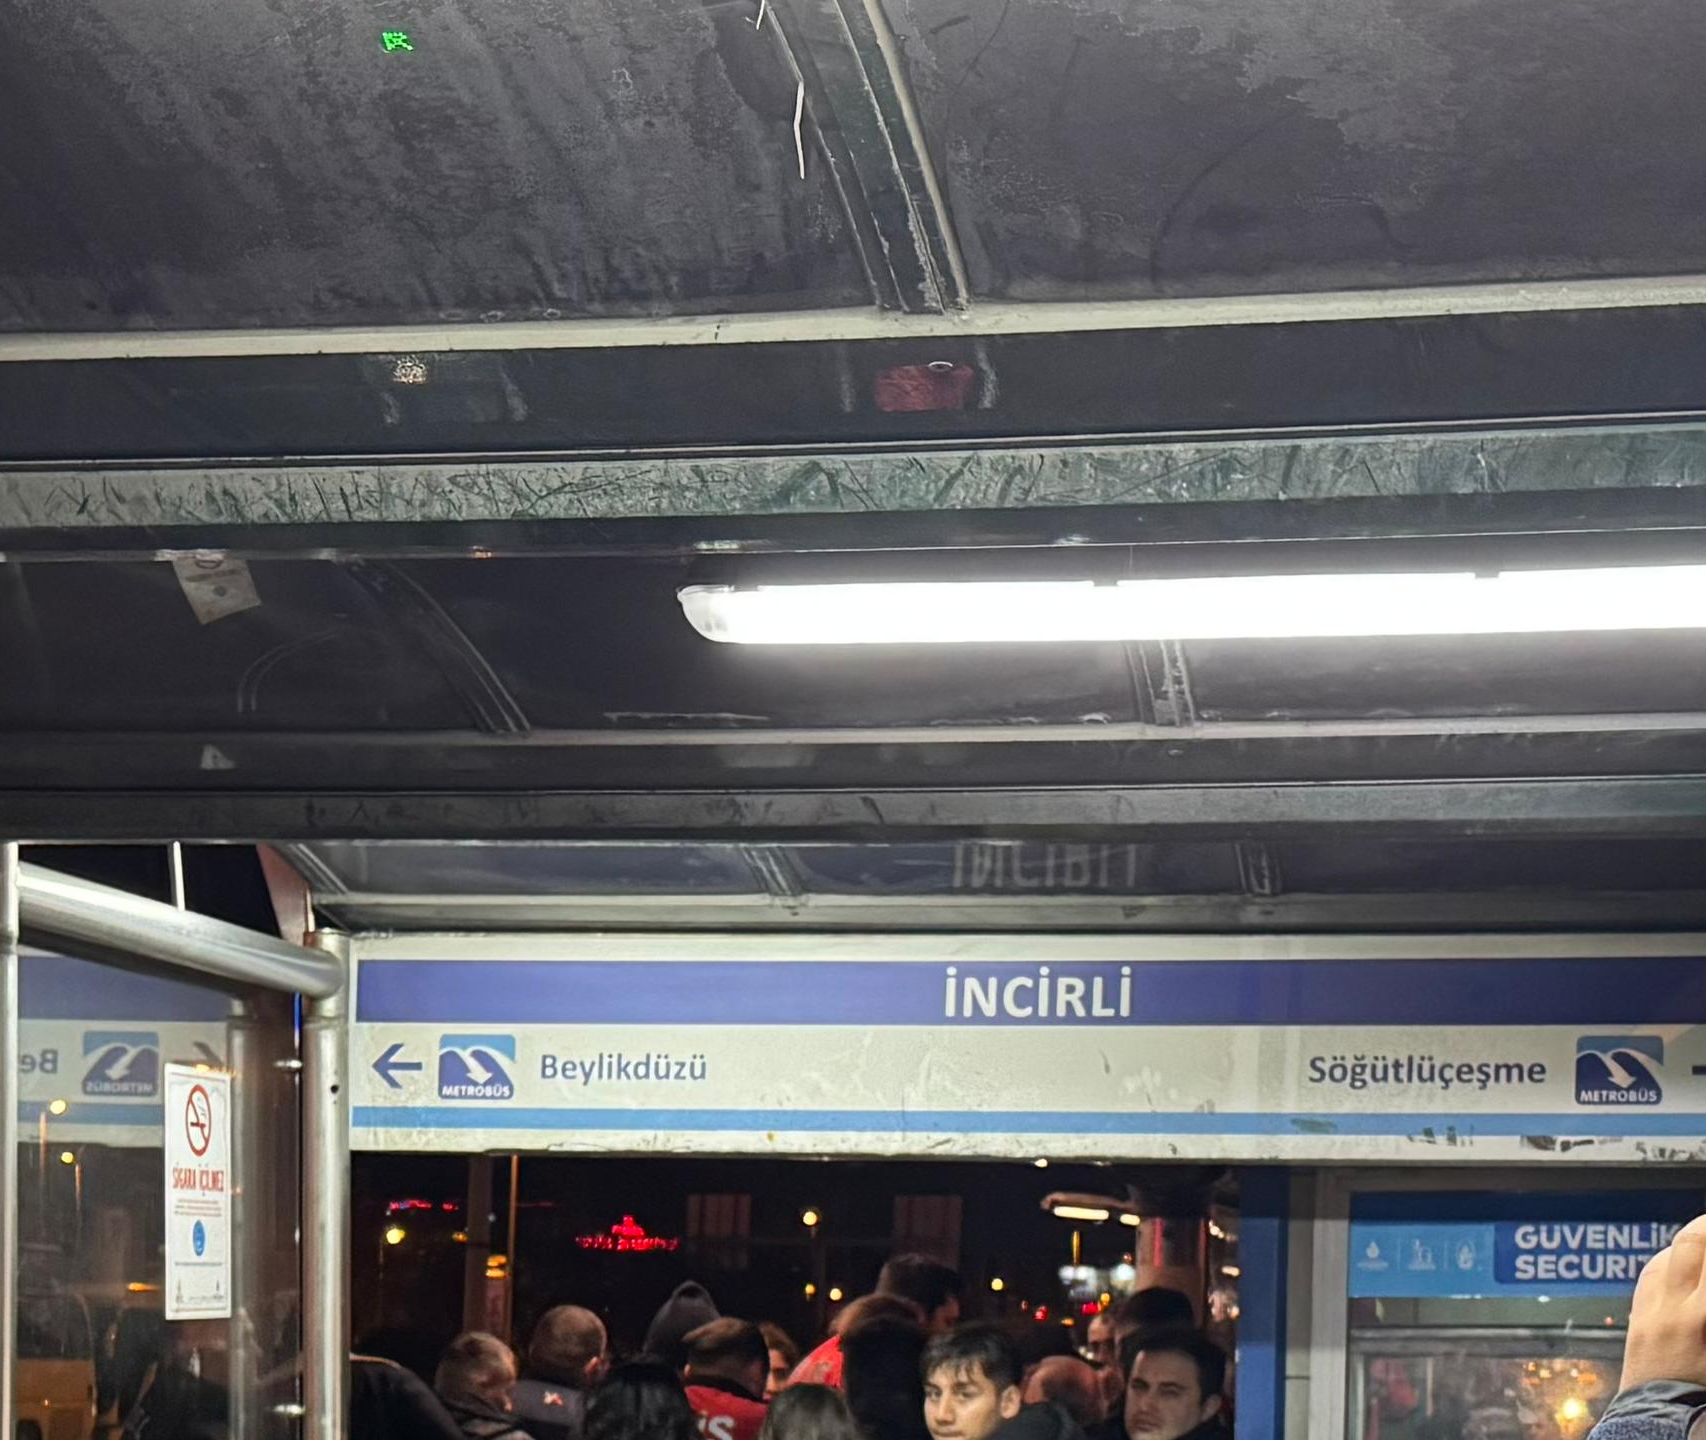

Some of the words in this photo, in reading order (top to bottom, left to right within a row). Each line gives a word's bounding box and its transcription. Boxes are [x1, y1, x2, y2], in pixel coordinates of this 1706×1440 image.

[944, 965, 1132, 1018] İNCİRLİ
[540, 1052, 708, 1086] Beylikdüzü
[1308, 1055, 1547, 1090] Söğütlüçeşme
[442, 1083, 510, 1098] METROBÜS
[1580, 1087, 1658, 1102] METROBÜS
